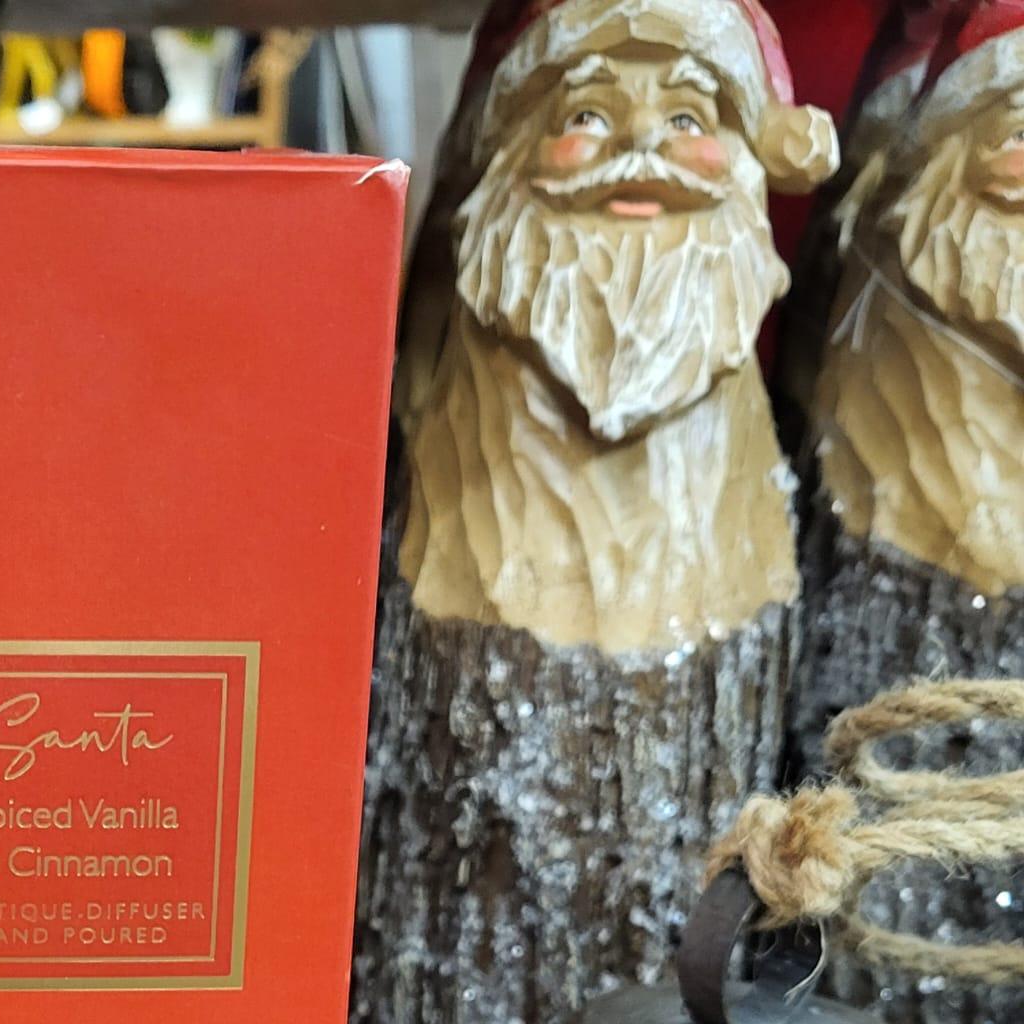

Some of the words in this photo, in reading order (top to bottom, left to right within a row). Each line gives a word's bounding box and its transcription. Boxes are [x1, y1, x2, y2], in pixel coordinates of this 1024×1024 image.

[79, 798, 179, 829] Vanilla
[8, 846, 173, 877] Cinnamon
[87, 902, 206, 920] DIFFUSER
[63, 926, 168, 944] POURED
